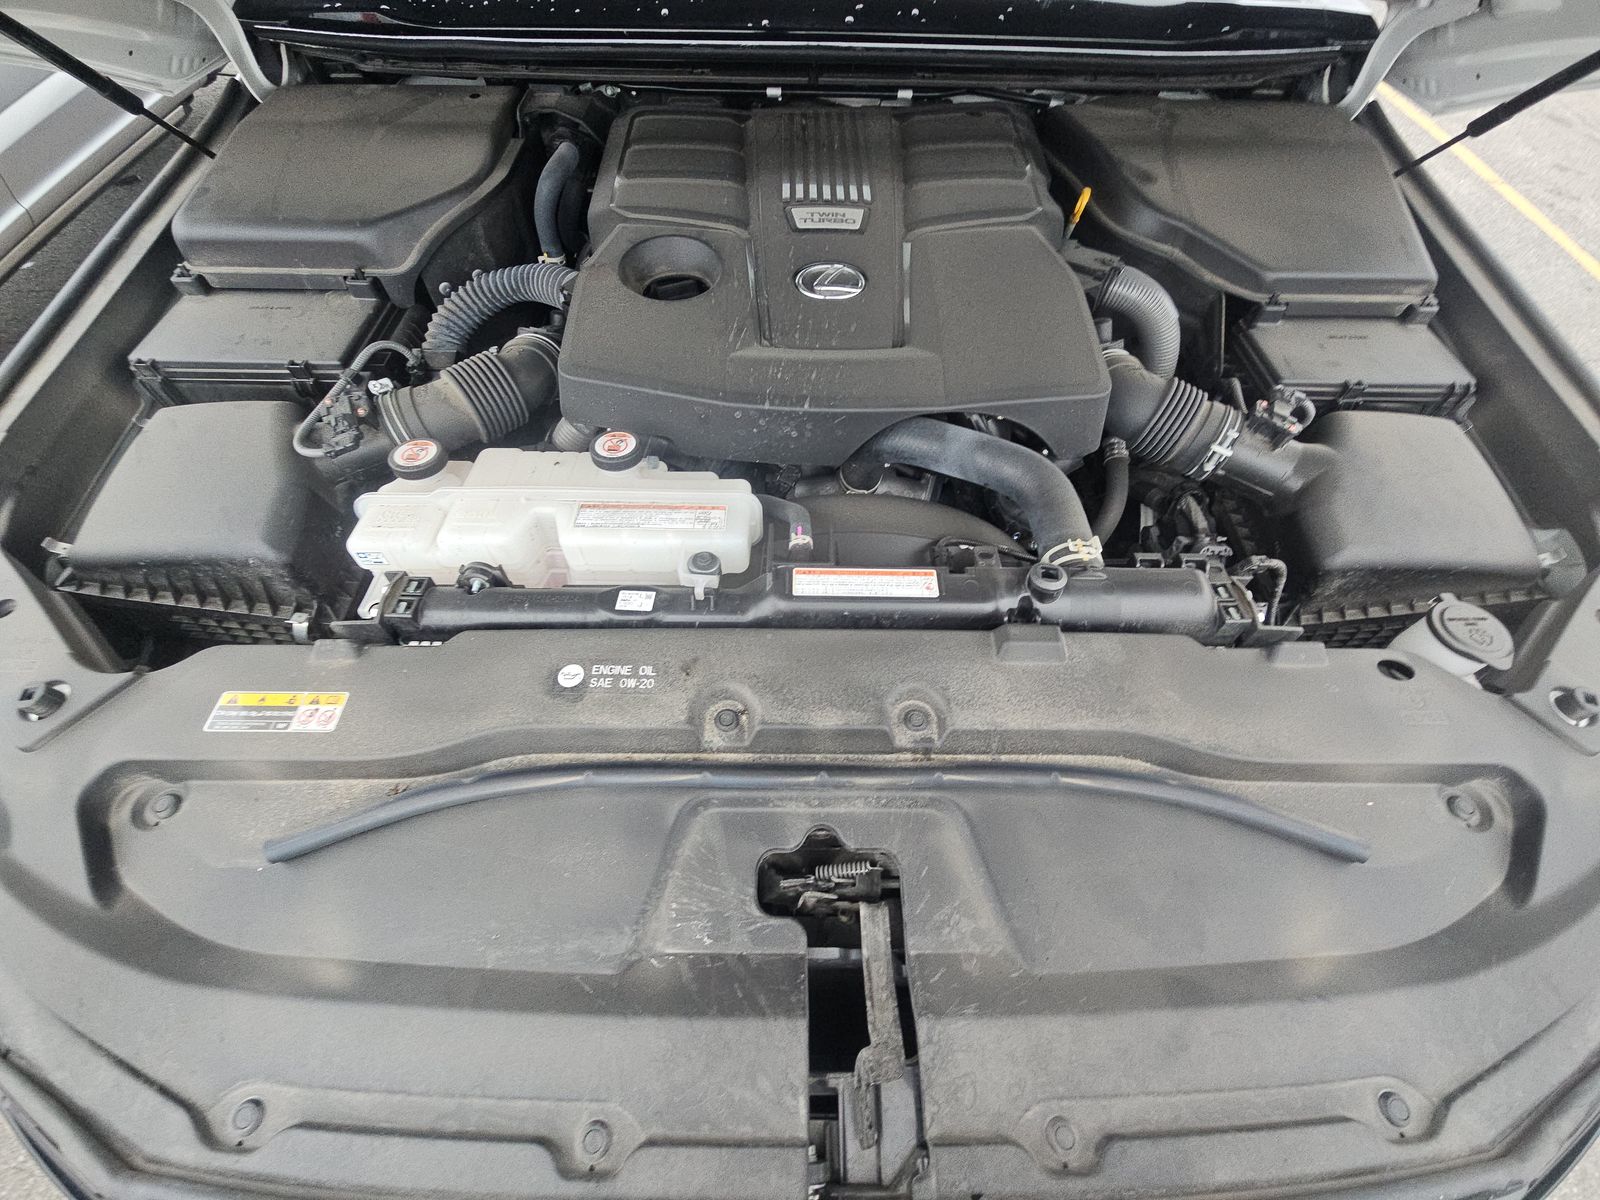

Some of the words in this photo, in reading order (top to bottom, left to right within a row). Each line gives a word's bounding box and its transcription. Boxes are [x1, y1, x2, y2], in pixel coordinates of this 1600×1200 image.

[591, 664, 633, 675] ENGINE
[638, 665, 657, 676] OIL
[588, 677, 614, 688] SAE
[619, 678, 655, 689] 0W-20
